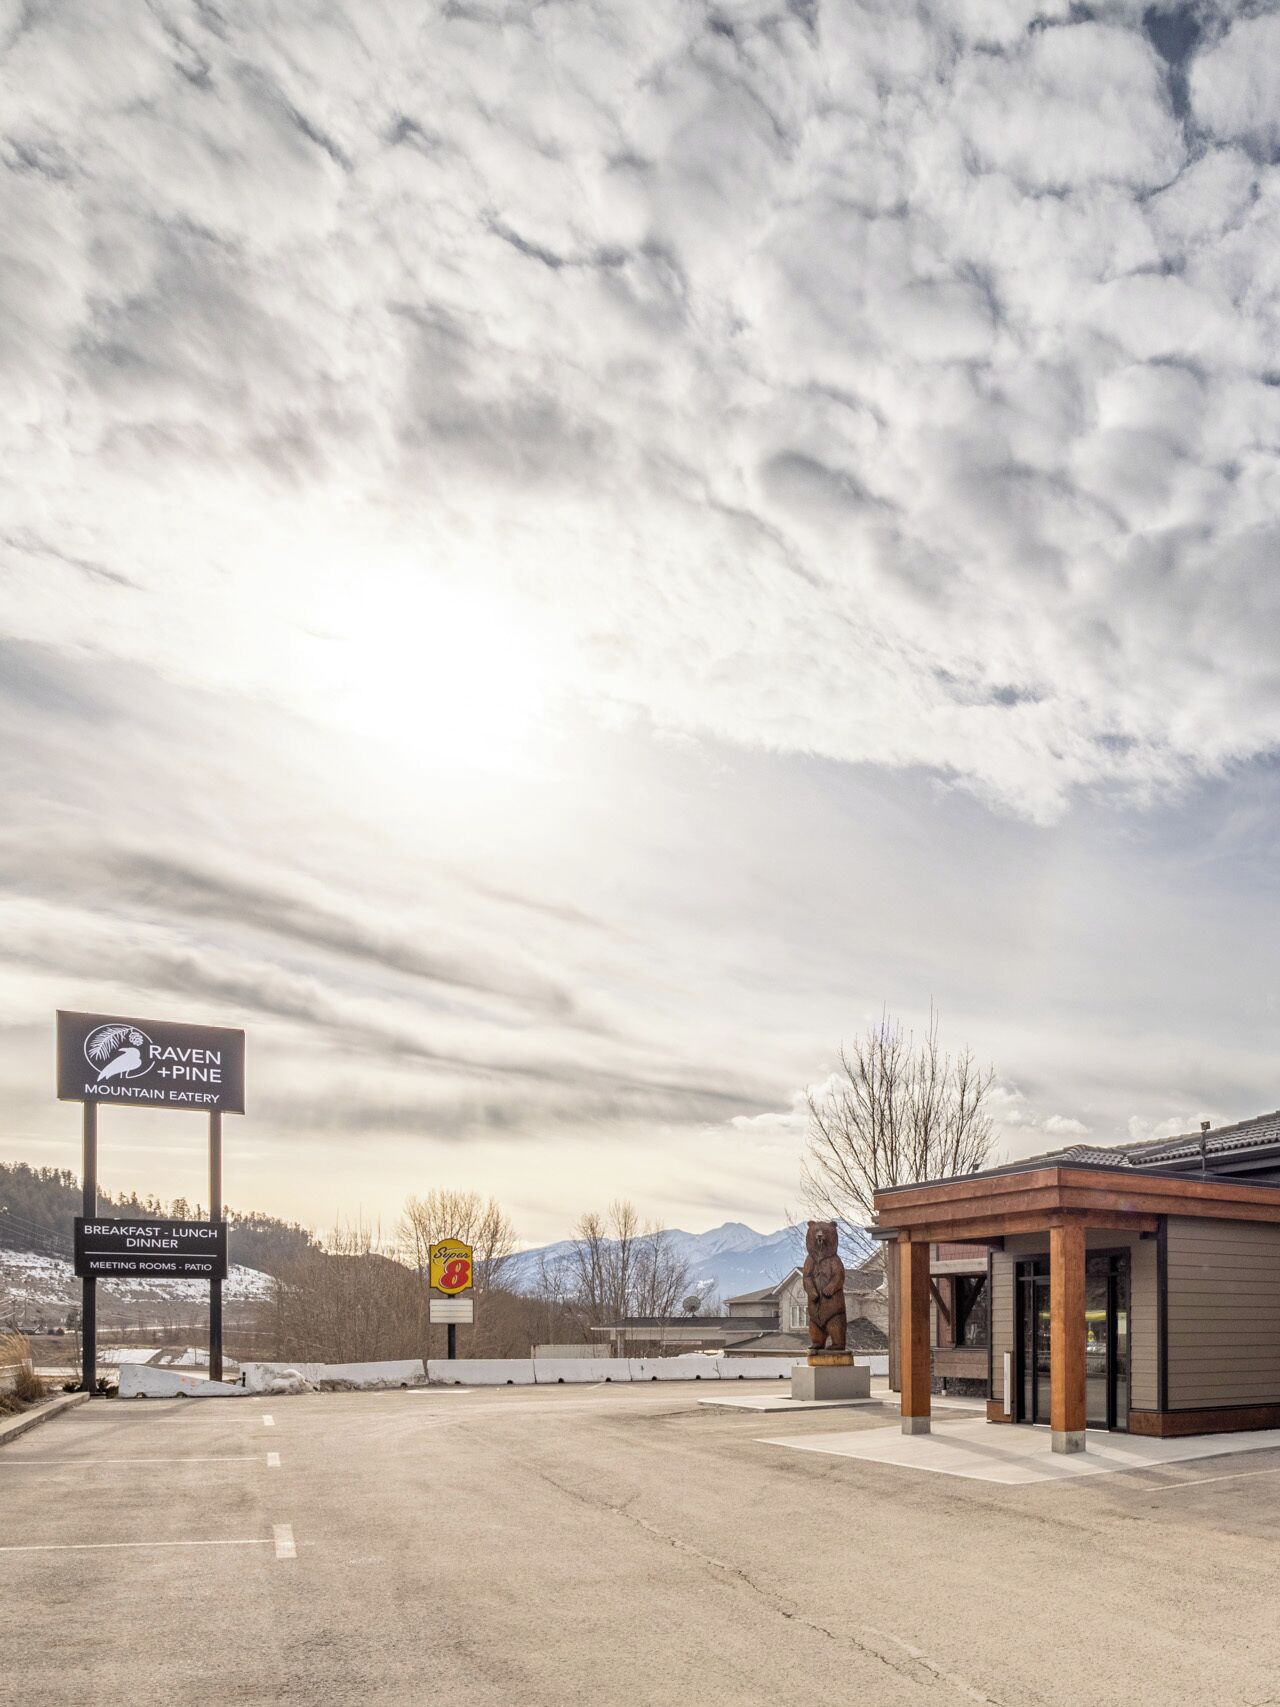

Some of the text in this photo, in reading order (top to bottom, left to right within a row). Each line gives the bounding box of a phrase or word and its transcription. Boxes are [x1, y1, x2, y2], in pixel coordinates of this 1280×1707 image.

[149, 1044, 221, 1065] RAVEN
[157, 1066, 222, 1083] +PINE
[84, 1083, 220, 1104] MOUNTAIN EATERY
[84, 1225, 161, 1237] BREAKFAST
[172, 1228, 218, 1238] LUNCH
[126, 1238, 178, 1248] DINNER
[433, 1246, 471, 1264] Super
[90, 1261, 137, 1270] MEETING
[139, 1262, 177, 1271] ROOMS
[184, 1263, 212, 1271] PATIO
[438, 1259, 470, 1289] 8
